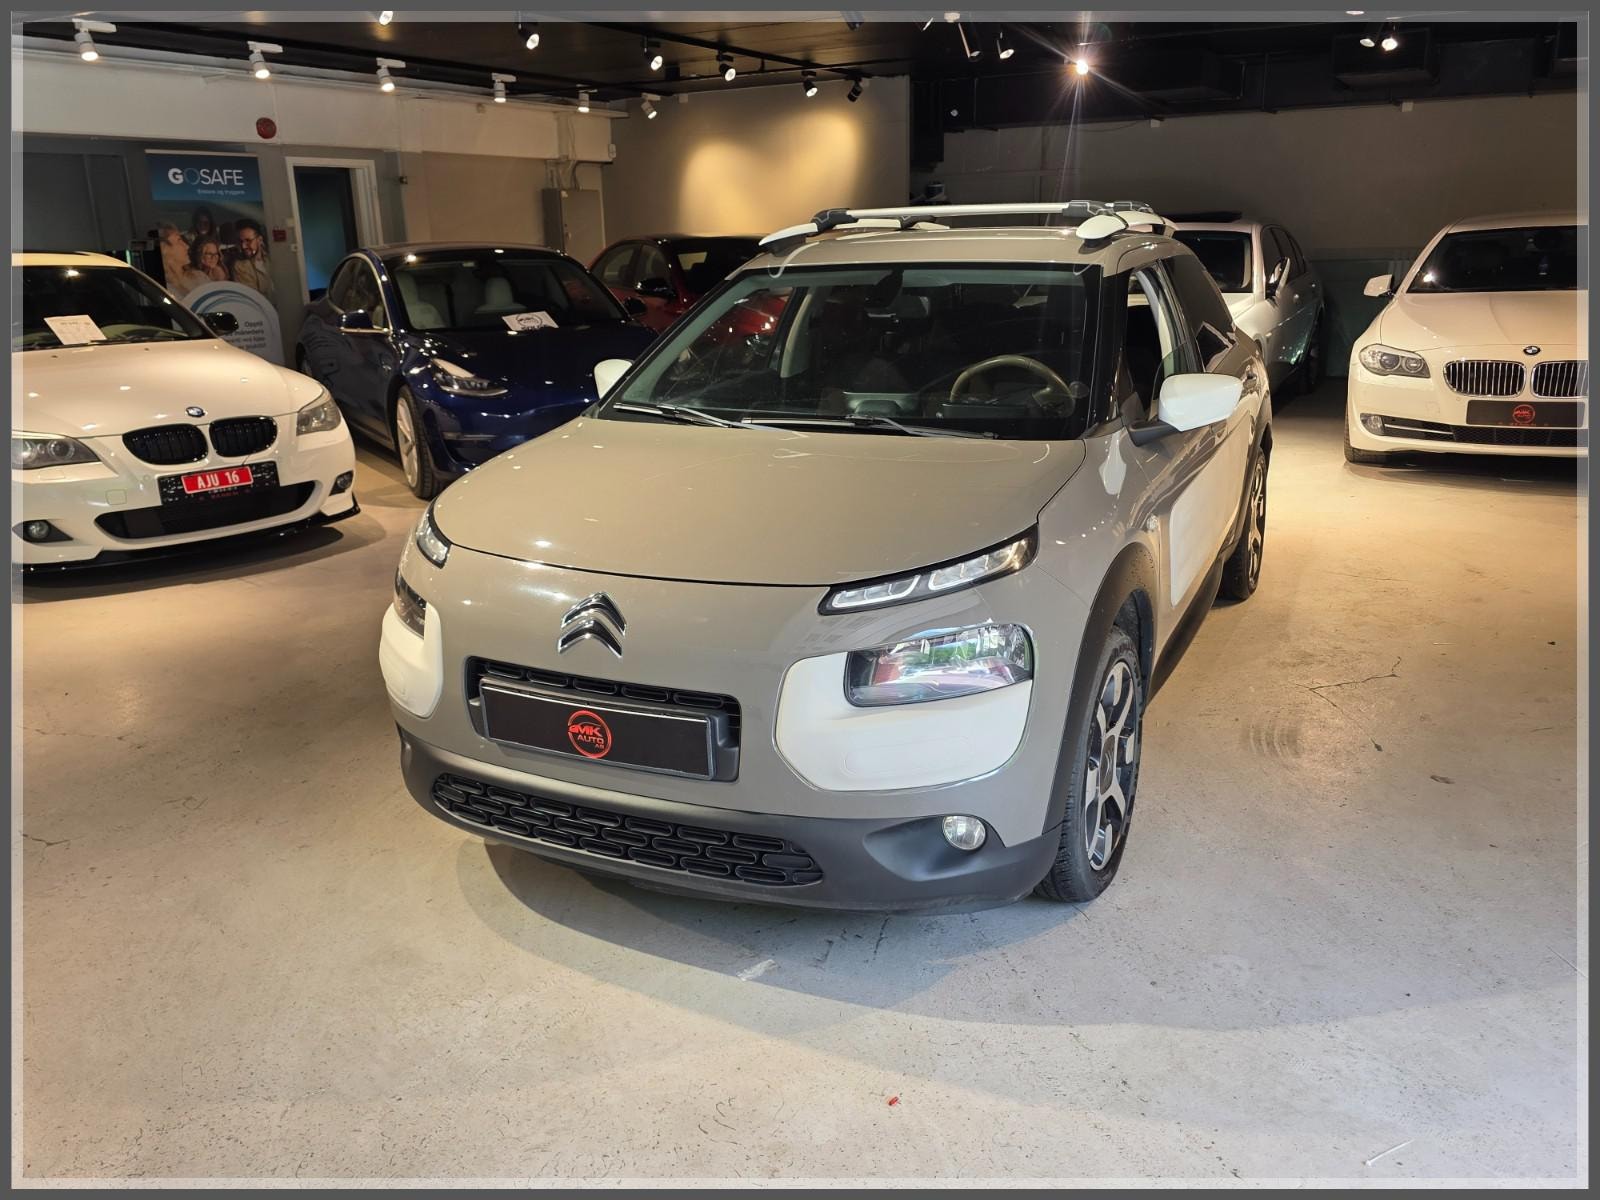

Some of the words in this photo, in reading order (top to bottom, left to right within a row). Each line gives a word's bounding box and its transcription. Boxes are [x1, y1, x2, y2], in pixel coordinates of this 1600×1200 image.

[168, 167, 245, 186] GOSAFE
[198, 473, 219, 489] AJU
[225, 470, 240, 484] 16
[578, 734, 604, 745] AUTO
